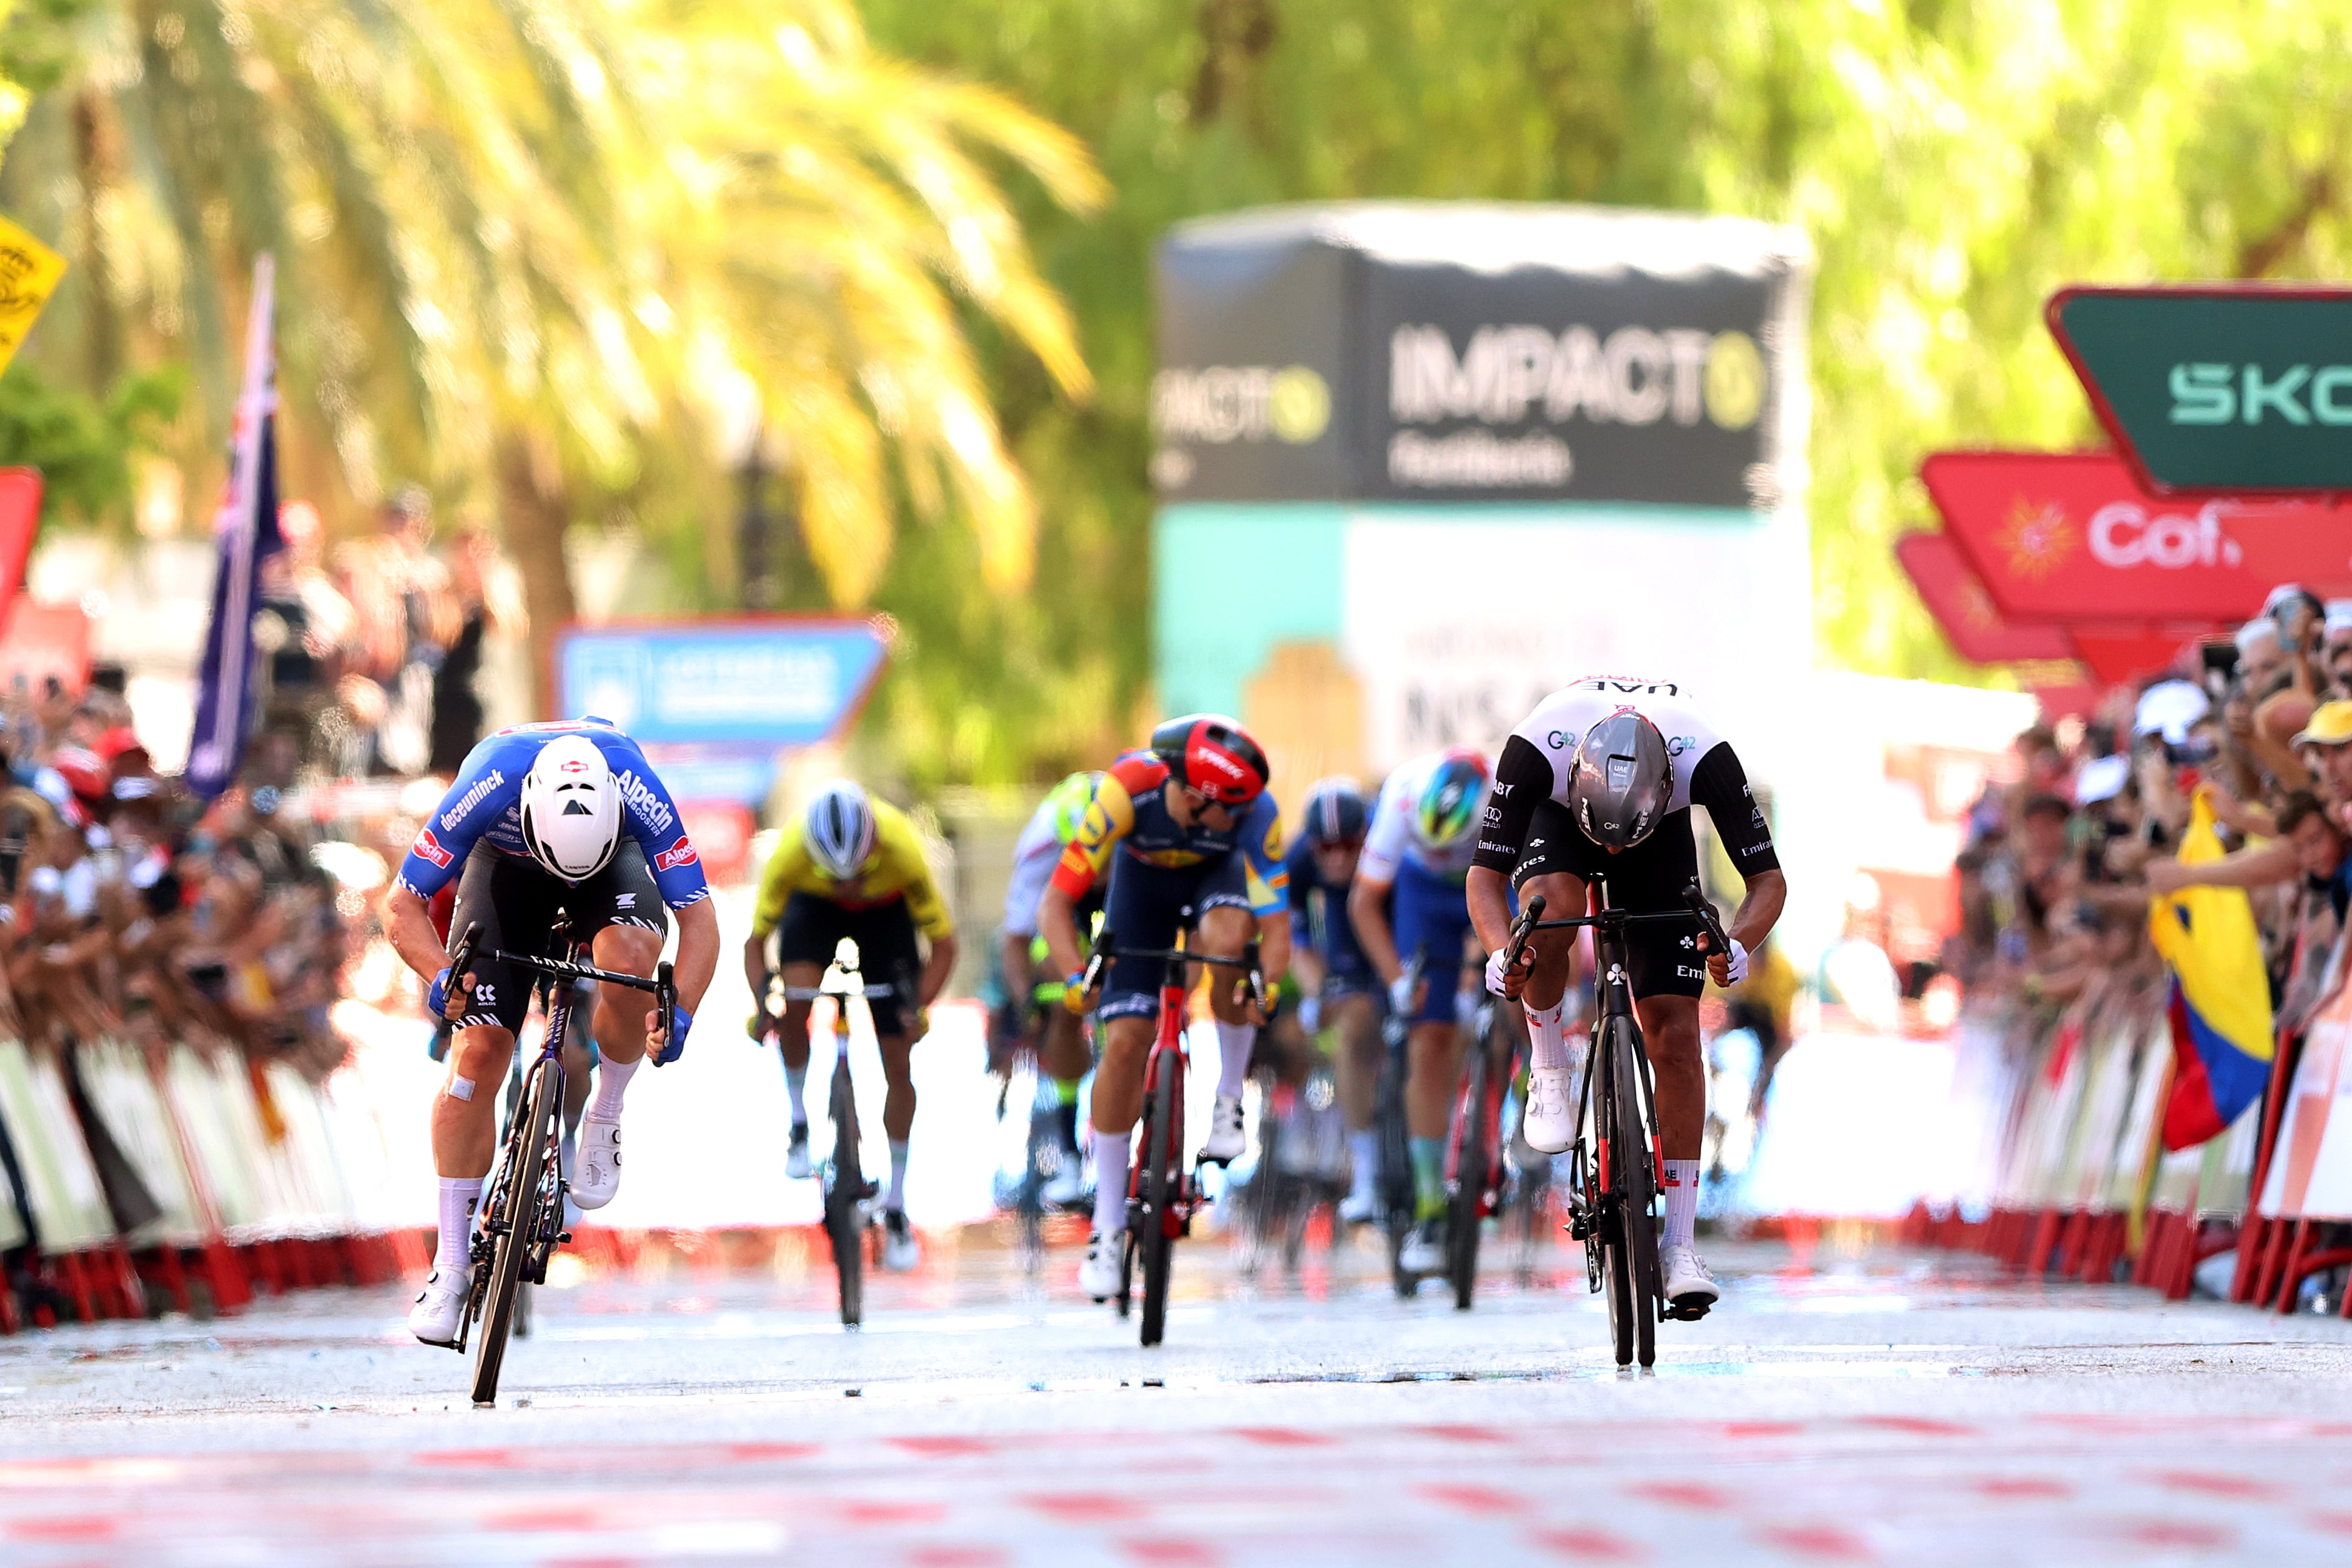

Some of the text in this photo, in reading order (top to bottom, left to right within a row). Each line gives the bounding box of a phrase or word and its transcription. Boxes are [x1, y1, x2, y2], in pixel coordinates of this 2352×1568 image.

[1579, 681, 1678, 697] UAE
[1548, 730, 1576, 750] G42
[1668, 736, 1696, 757] G42
[1614, 764, 1629, 773] UAE
[440, 769, 505, 832] deceuninck
[618, 769, 673, 832] Alpecin
[630, 802, 661, 837] BOOSTER
[1604, 822, 1620, 830] G42
[415, 833, 443, 860] pecin
[1478, 839, 1516, 854] Emirates
[530, 955, 606, 977] CANYON
[545, 1005, 558, 1042] CANYON
[553, 1007, 566, 1043] CANYON
[1664, 1169, 1676, 1180] AE
